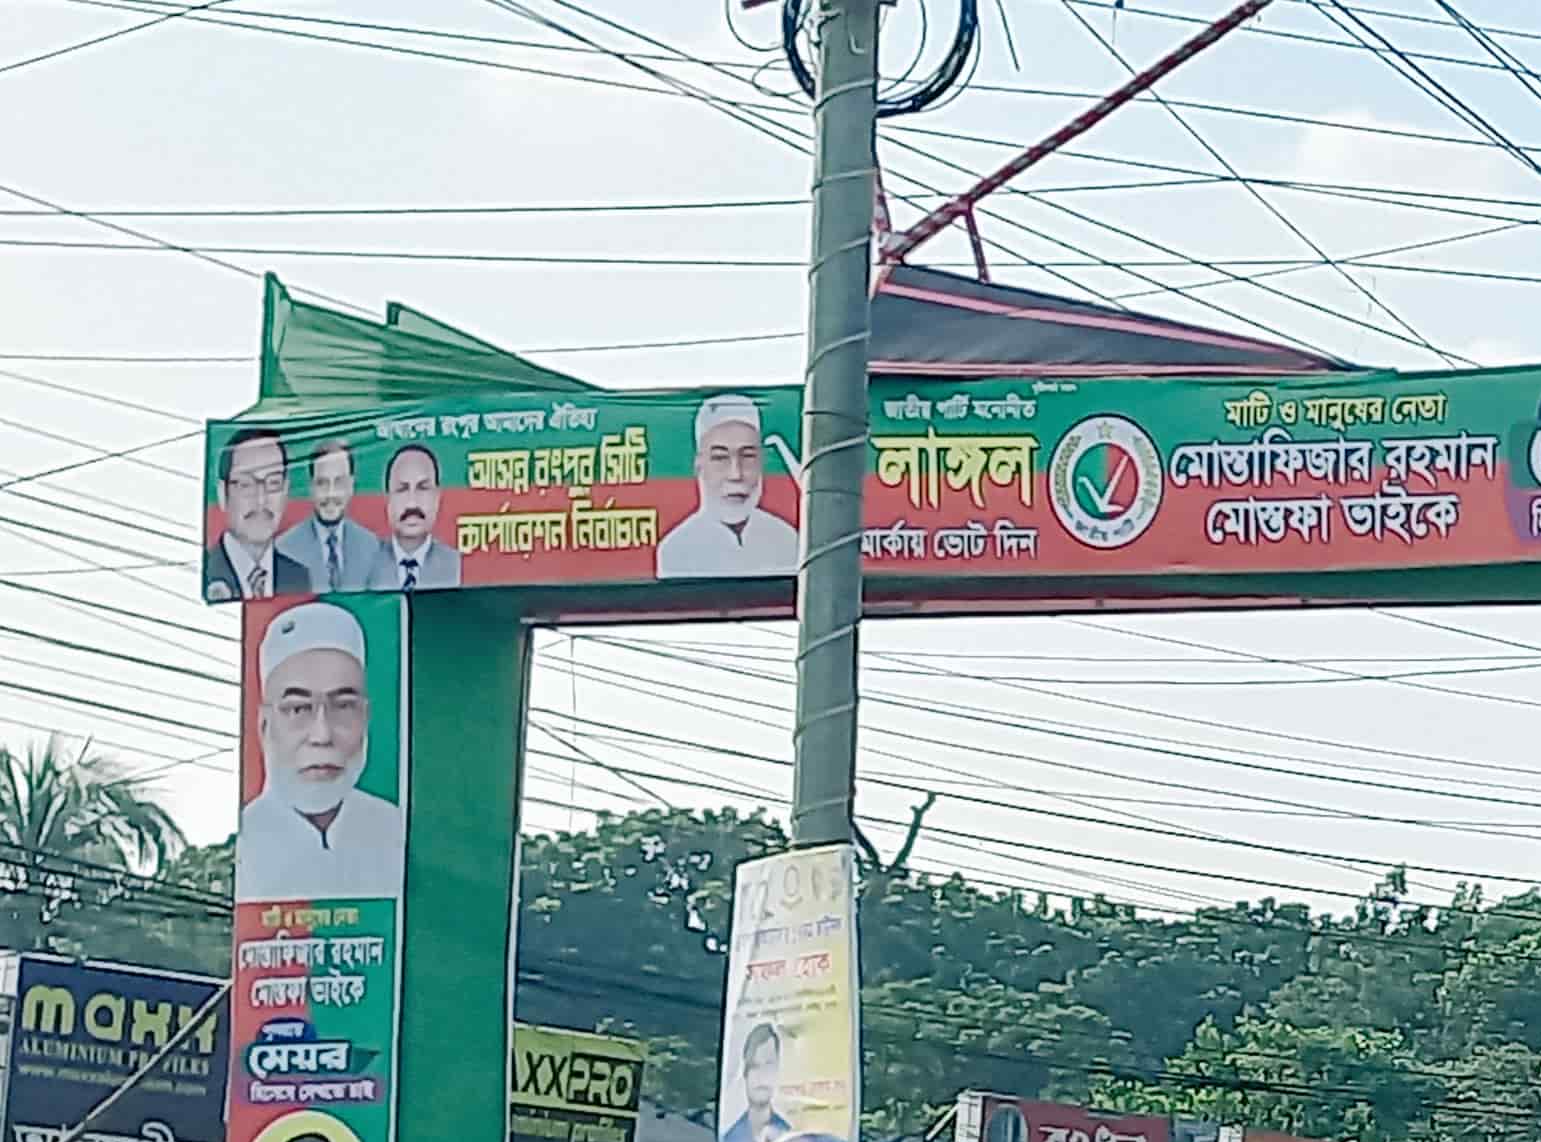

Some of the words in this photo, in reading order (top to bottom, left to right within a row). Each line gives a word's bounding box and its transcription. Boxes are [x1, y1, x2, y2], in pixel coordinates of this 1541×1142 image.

[1224, 390, 1273, 426] মাটি
[1279, 400, 1297, 425] ও
[1304, 394, 1385, 431] মানুষের
[1391, 393, 1449, 424] নেতা
[534, 447, 596, 498] রংপুর
[599, 426, 648, 485] সিটি
[870, 426, 1040, 509] লাঙ্গল
[1169, 428, 1374, 488] মোস্তাফিজার
[1383, 430, 1500, 483] রহমান
[933, 520, 988, 560] ভোট
[990, 519, 1039, 561] দিন
[1206, 493, 1332, 545] মোস্তফা
[1341, 479, 1462, 544] ভাইকে
[21, 1038, 123, 1066] ALUMINIUM
[128, 1050, 210, 1076] PRILES
